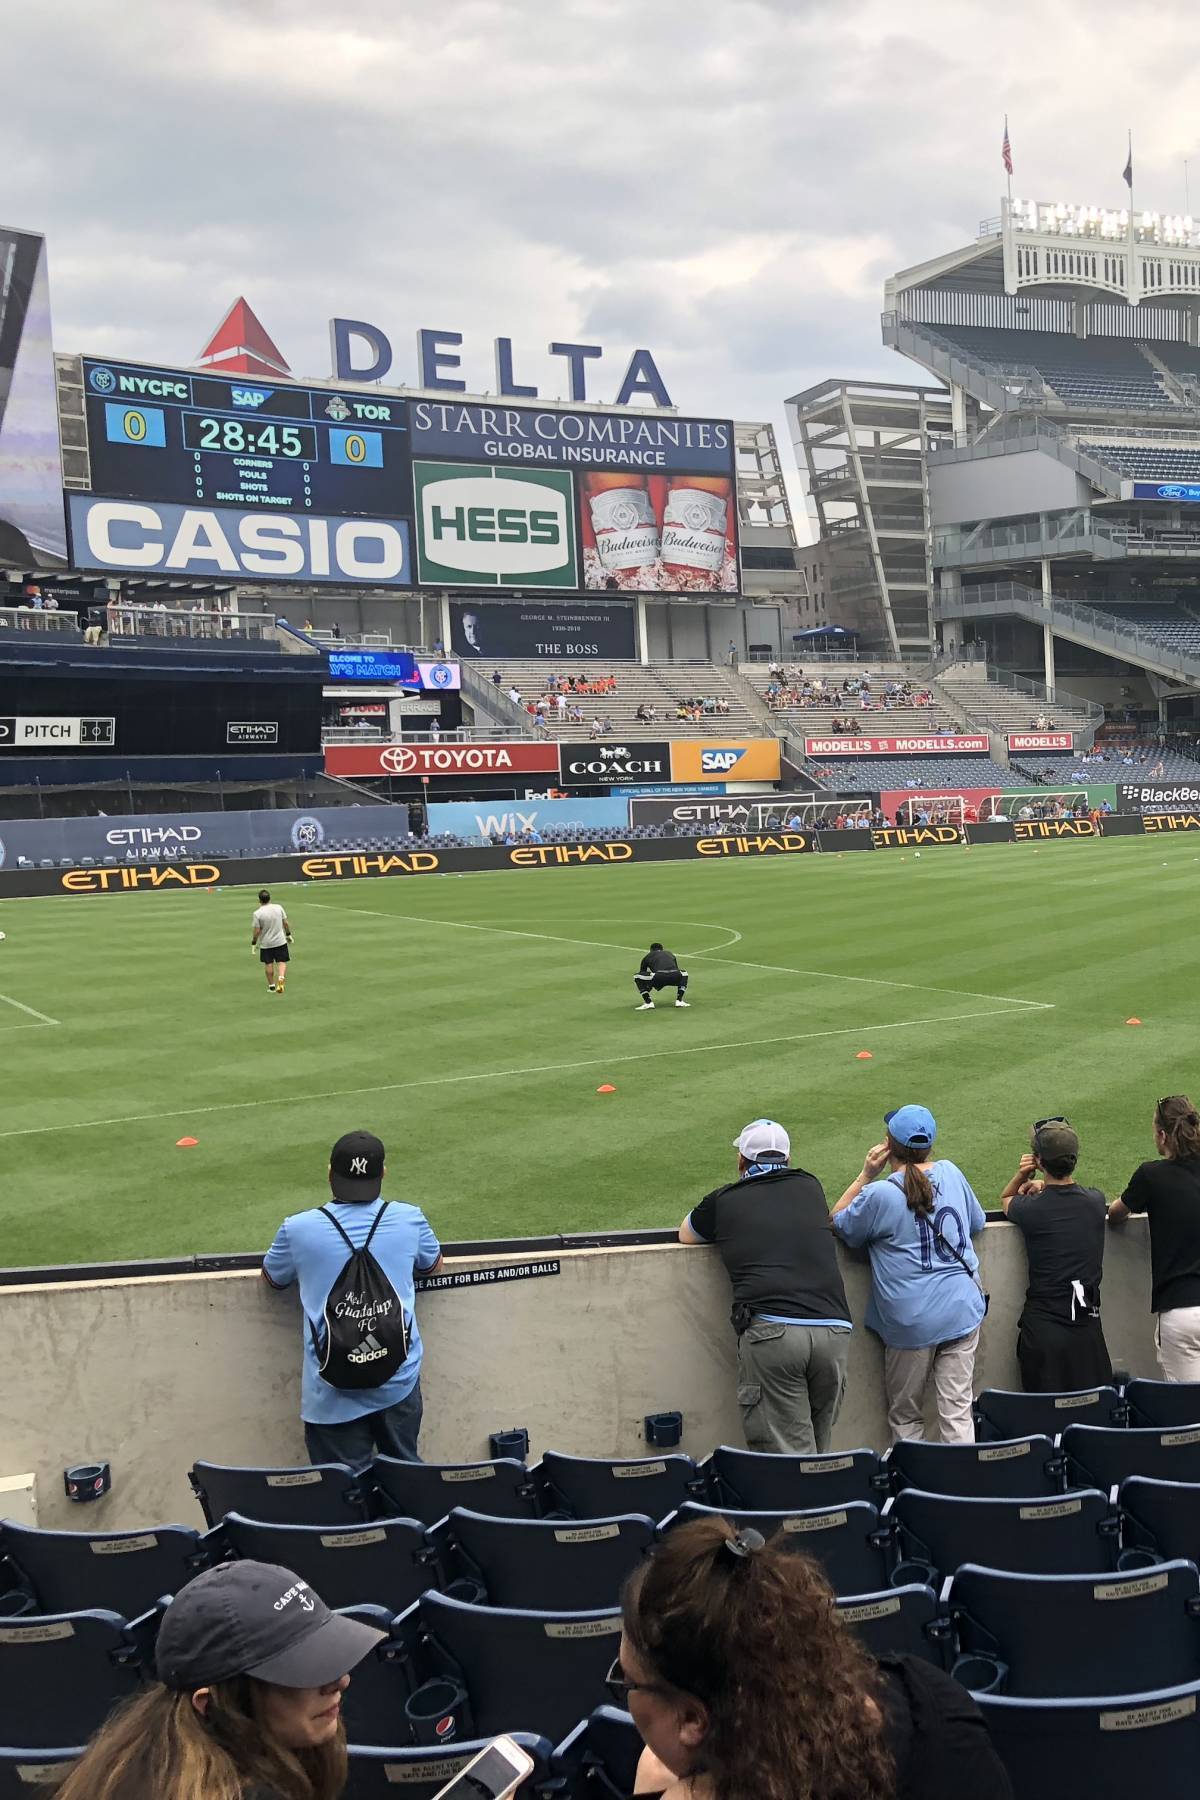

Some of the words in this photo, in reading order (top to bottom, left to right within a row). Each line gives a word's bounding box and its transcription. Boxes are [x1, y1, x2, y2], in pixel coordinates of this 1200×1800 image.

[329, 318, 673, 407] DELTA
[120, 375, 188, 398] NYCFC
[232, 390, 265, 407] SAP
[353, 403, 390, 421] TOR
[123, 411, 147, 441] 0
[415, 404, 529, 437] STARR
[534, 413, 728, 449] COMPANIES
[200, 419, 302, 457] 28:45
[345, 435, 366, 463] 0
[484, 440, 557, 460] GLOBAL
[562, 446, 665, 466] INSURANCE
[233, 458, 273, 469] CORNERS
[240, 482, 268, 492] SHOTS
[216, 492, 244, 502] SHOTS
[246, 494, 258, 502] ON
[260, 495, 293, 505] TARGET
[432, 505, 559, 545] HESS
[87, 502, 402, 578] CASIO
[364, 654, 375, 663] TO
[536, 643, 562, 655] THE
[565, 643, 600, 655] BOSS
[356, 664, 401, 676] MATCH
[24, 724, 72, 739] PITCH
[229, 725, 276, 735] ETIHAD
[811, 739, 868, 753] MODELL'S
[896, 738, 983, 751] MODELLS.com
[1014, 736, 1067, 748] MODELL'S
[419, 749, 513, 769] TOYOTA
[569, 761, 662, 774] COACH
[702, 752, 738, 770] SAP
[525, 788, 568, 801] FedEx
[106, 826, 202, 846] ETIHAD
[696, 834, 806, 855] ETIHAD
[126, 845, 188, 857] AIRWAYS
[510, 843, 633, 865] ETIHAD
[302, 852, 439, 879] ETIHAD
[61, 864, 221, 890] ETIHAD
[914, 1205, 967, 1271] 10
[426, 1276, 453, 1288] ALERT
[454, 1274, 471, 1284] FOR
[473, 1271, 495, 1282] BATS
[497, 1266, 530, 1279] AND/OR
[532, 1262, 558, 1274] BALLS
[335, 1299, 392, 1319] Guadalup
[358, 1316, 377, 1332] FC
[347, 1348, 388, 1364] adidas
[273, 1587, 298, 1610] CAPE
